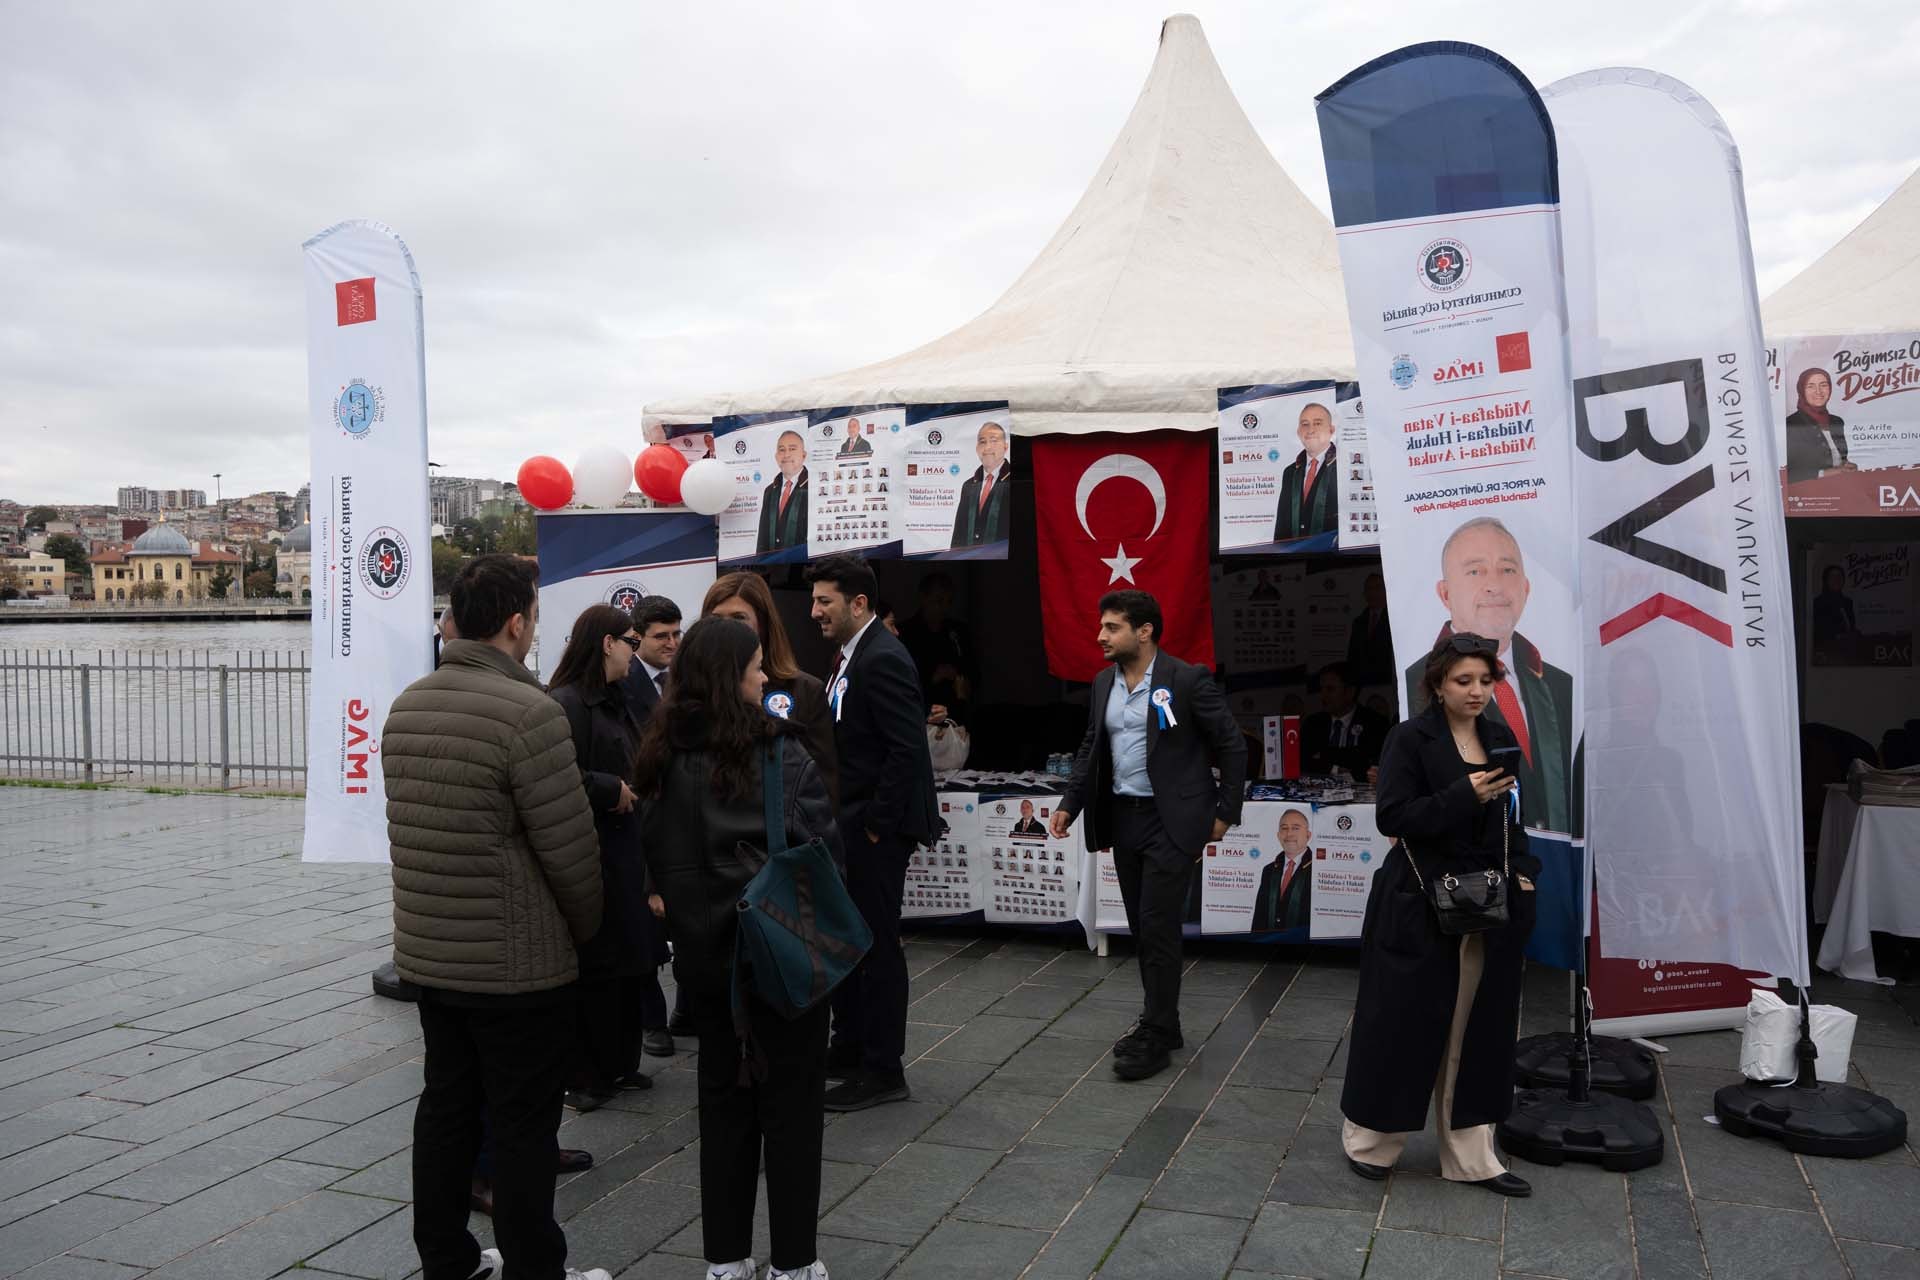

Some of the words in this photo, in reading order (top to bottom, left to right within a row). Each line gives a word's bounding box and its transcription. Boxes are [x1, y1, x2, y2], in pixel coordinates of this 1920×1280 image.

[1833, 348, 1908, 374] Bağımsız
[1852, 432, 1898, 441] GÖKKAYA
[1879, 485, 1920, 507] BA
